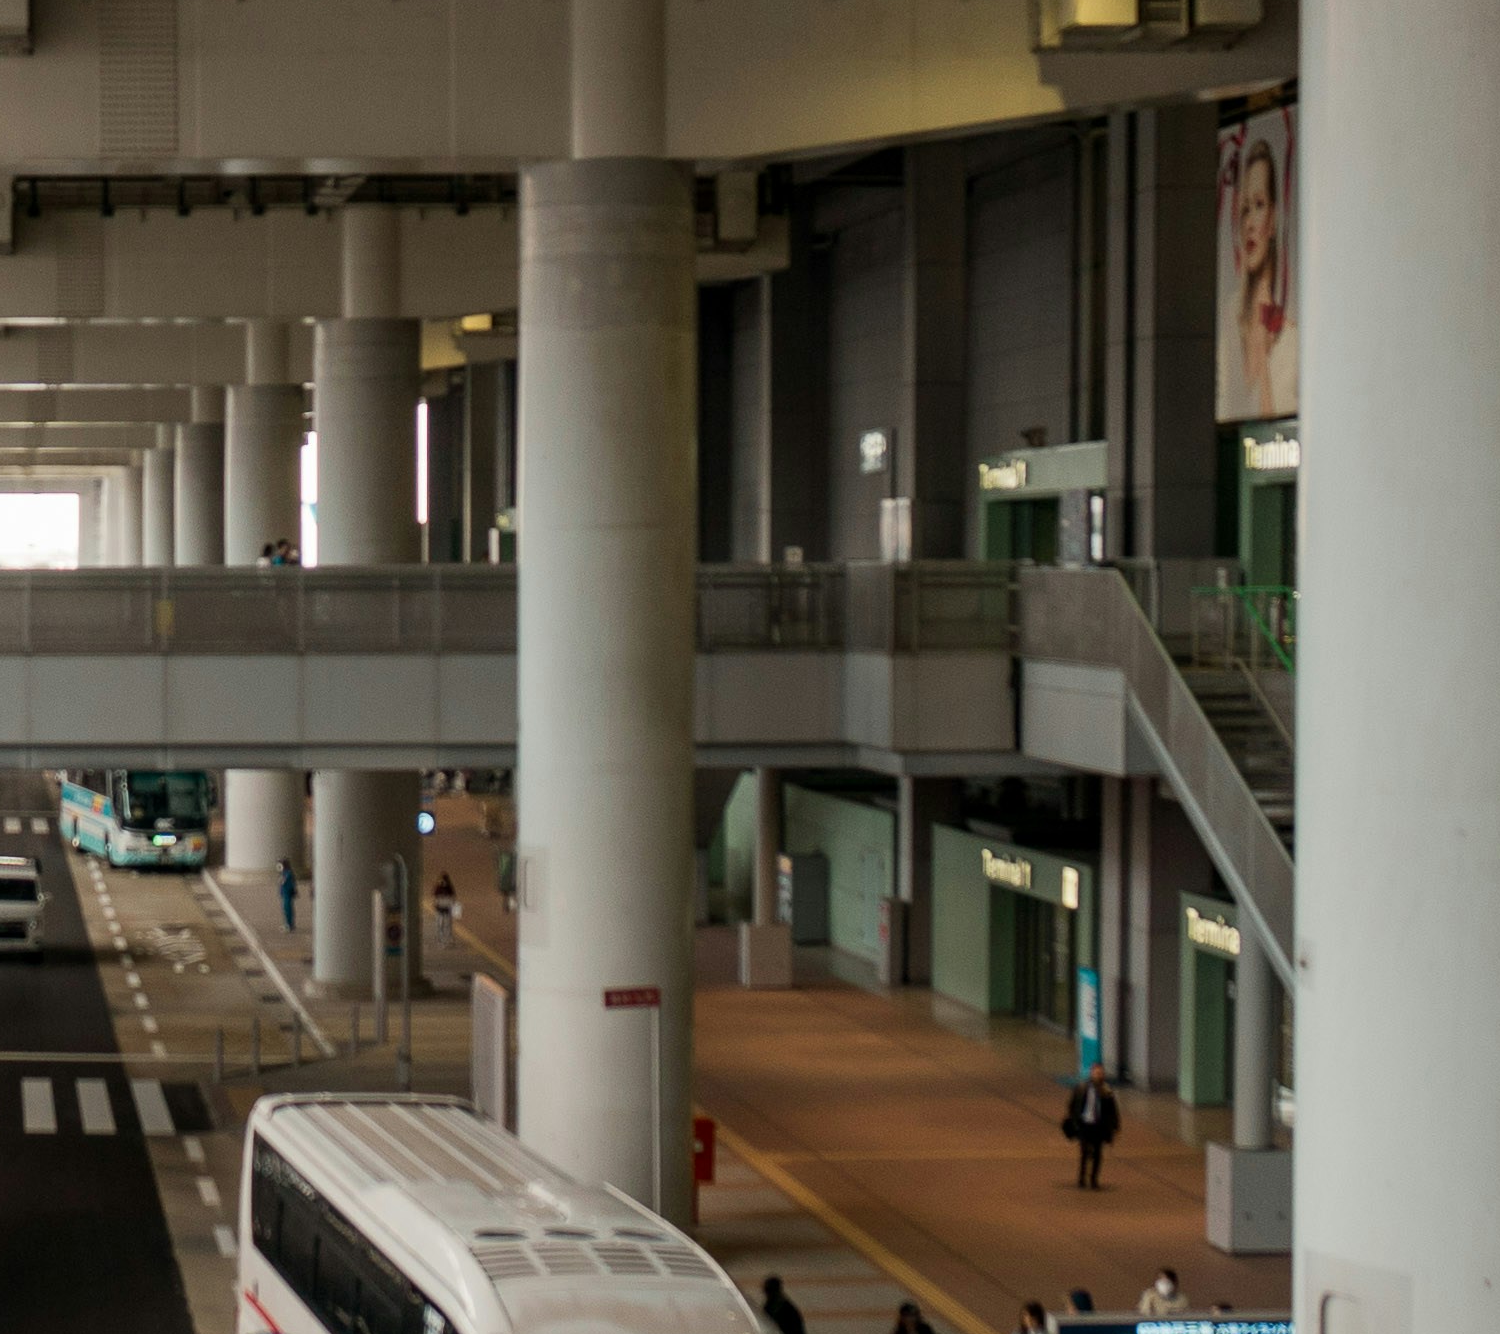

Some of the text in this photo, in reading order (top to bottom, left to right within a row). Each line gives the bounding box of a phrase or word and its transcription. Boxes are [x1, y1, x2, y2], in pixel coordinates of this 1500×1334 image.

[1243, 432, 1301, 469] Termina
[981, 848, 1023, 887] Terminal
[1186, 906, 1241, 955] Termina
